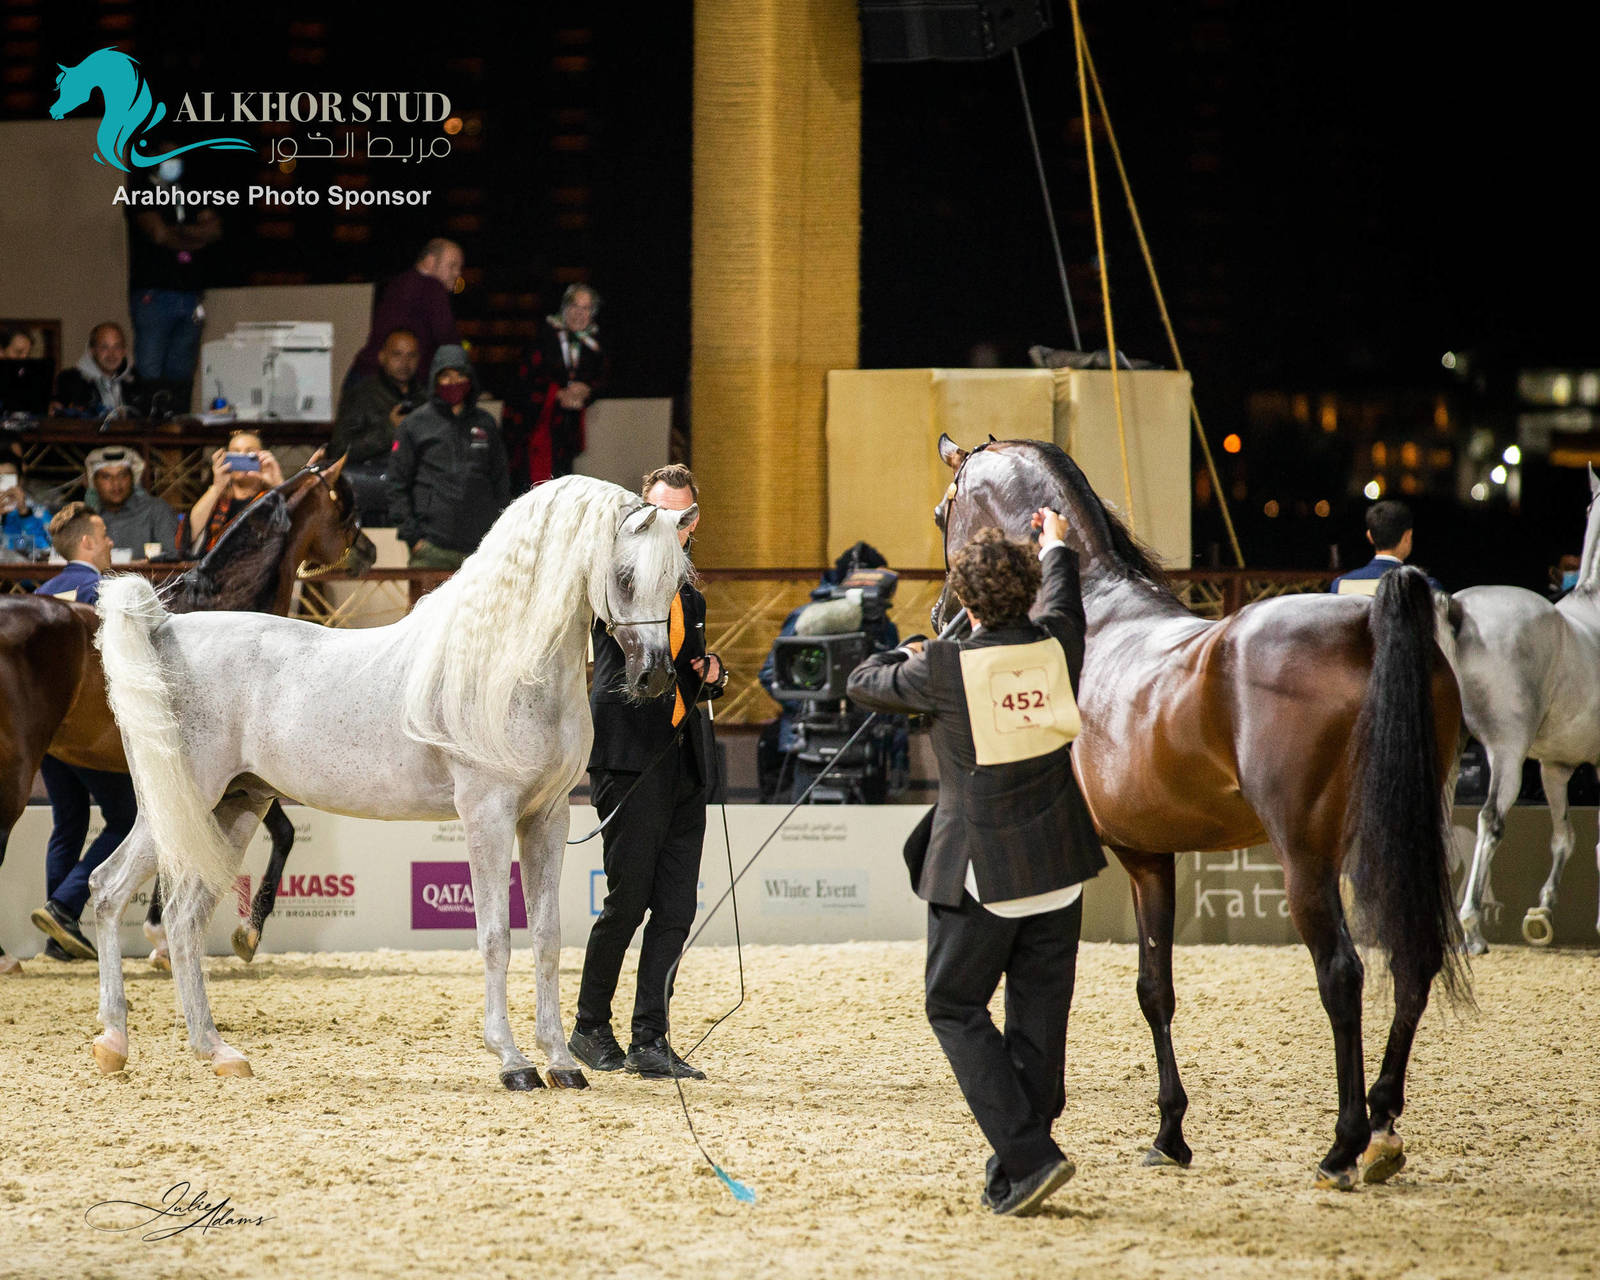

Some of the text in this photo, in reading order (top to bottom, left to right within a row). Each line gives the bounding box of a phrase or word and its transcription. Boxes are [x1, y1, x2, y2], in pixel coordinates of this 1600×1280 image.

[1002, 690, 1045, 711] 452
[276, 874, 355, 897] LKASS
[422, 884, 473, 908] QATA
[765, 879, 857, 898] White Event
[1194, 879, 1290, 918] kata
